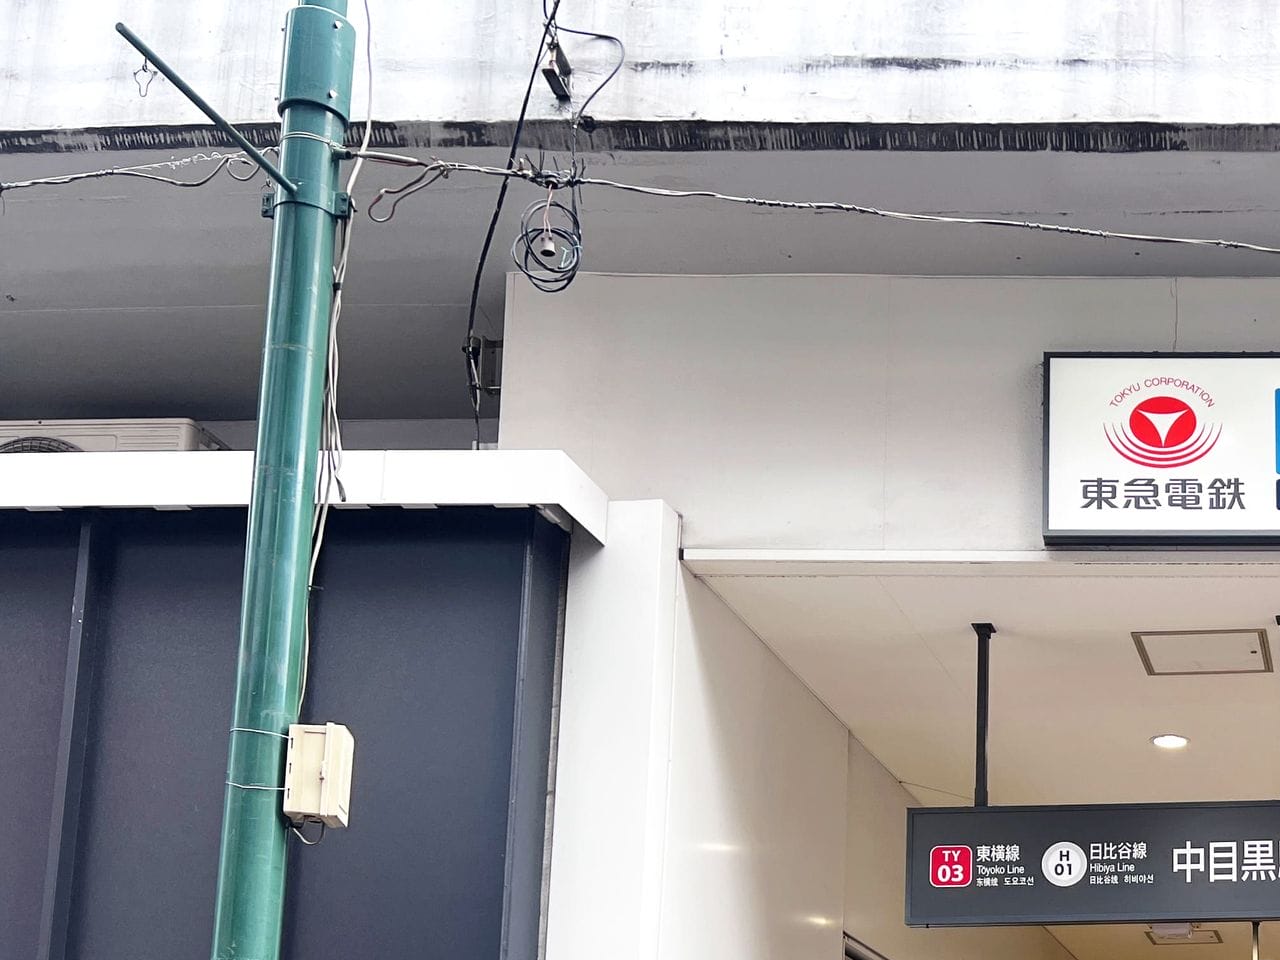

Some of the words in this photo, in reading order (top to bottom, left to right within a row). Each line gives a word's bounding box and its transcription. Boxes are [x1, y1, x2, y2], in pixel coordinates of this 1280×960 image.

[1109, 383, 1141, 408] TOKYU
[1144, 377, 1216, 408] CORPORATION
[1080, 477, 1246, 510] 東急電鉄
[942, 850, 962, 861] TY
[976, 844, 1020, 862] 東横線
[1059, 850, 1070, 862] H
[1090, 842, 1147, 860] 日比谷線
[937, 865, 964, 883] 03
[976, 864, 1005, 877] Toyoko
[1007, 864, 1025, 874] Line
[1054, 863, 1073, 876] 01
[1090, 862, 1115, 875] Hibiya
[1117, 862, 1135, 872] Line
